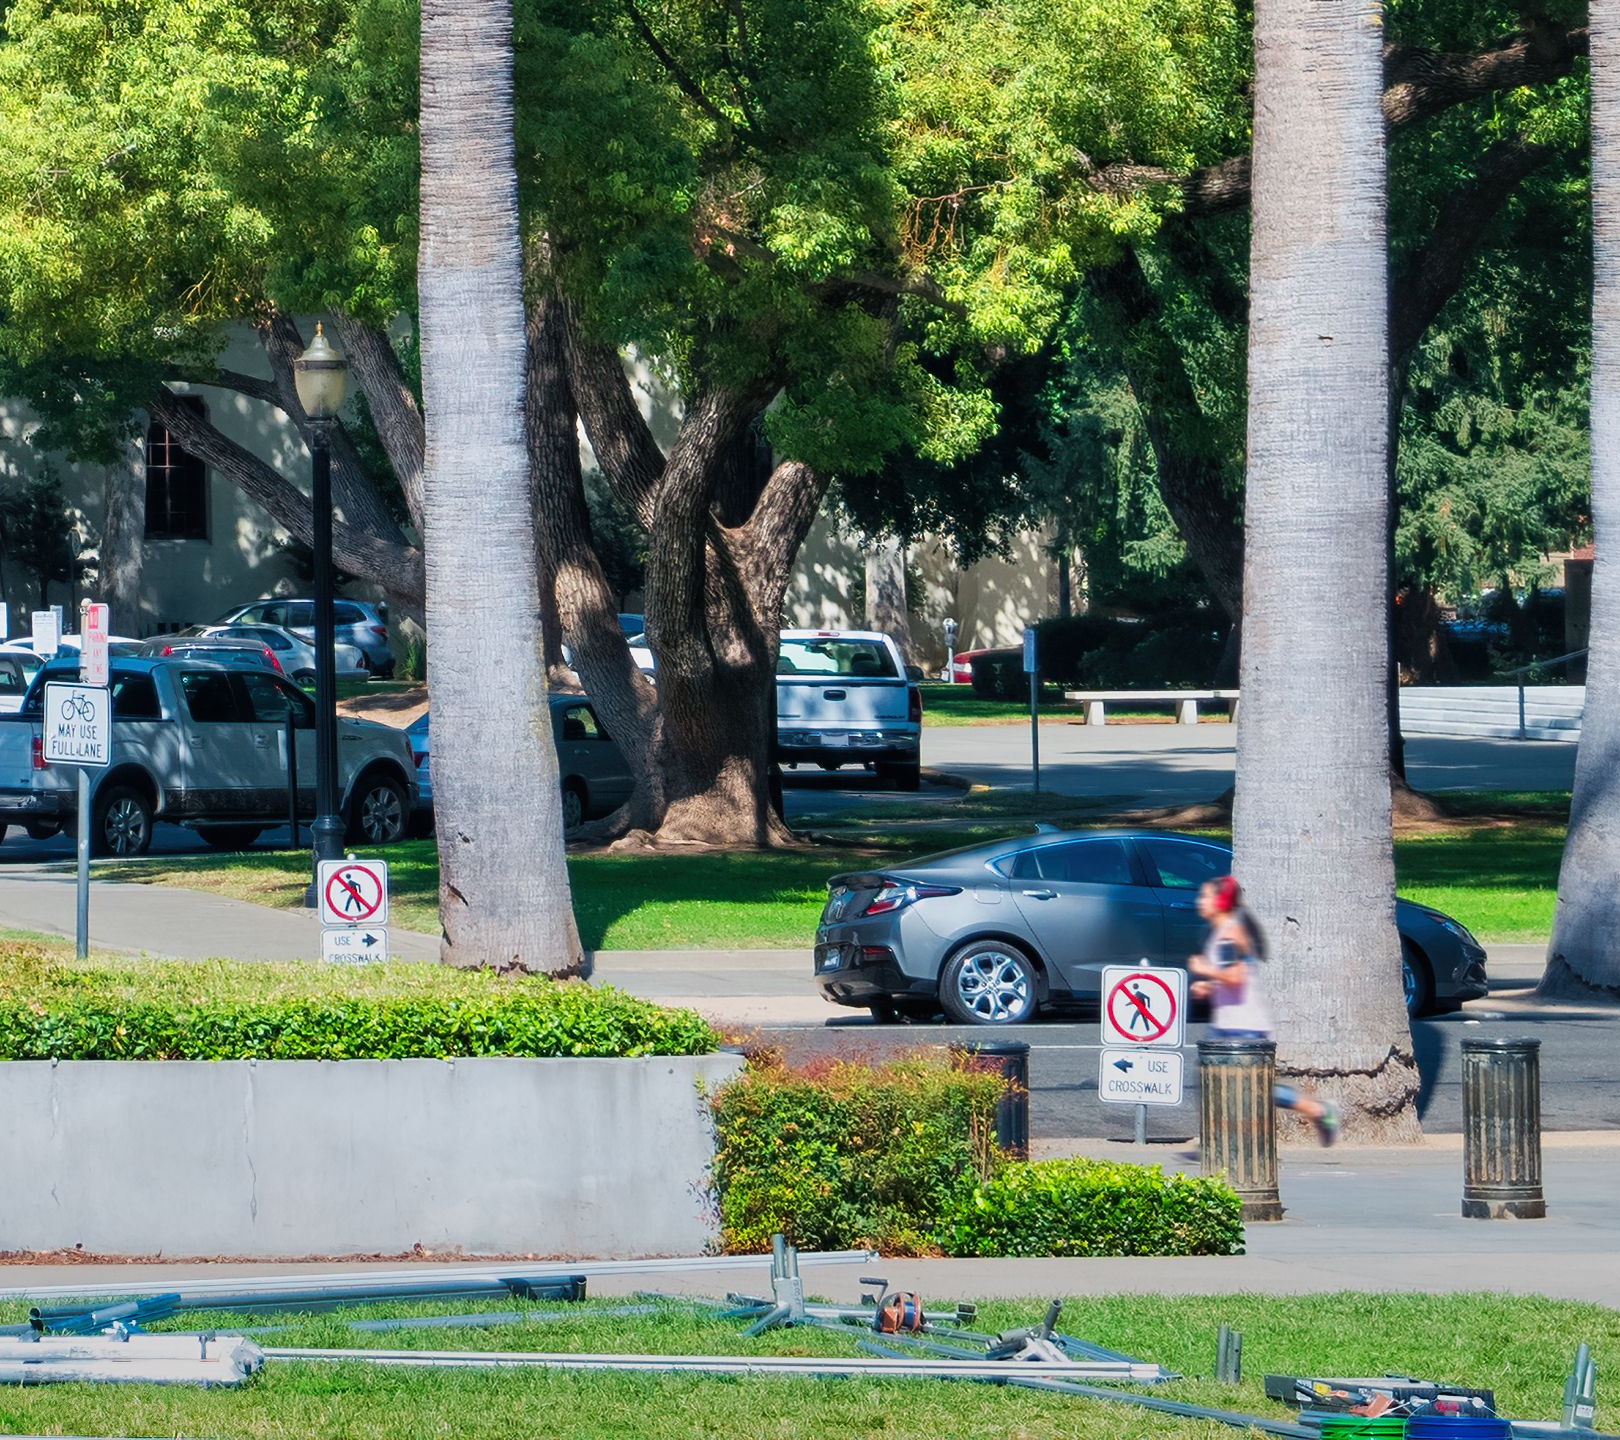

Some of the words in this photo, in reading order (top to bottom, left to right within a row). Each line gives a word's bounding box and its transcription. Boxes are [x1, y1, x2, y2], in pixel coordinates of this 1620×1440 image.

[57, 723, 77, 738] MAY
[79, 725, 98, 740] USE
[51, 739, 76, 756] FULL
[78, 742, 103, 759] LANE
[334, 936, 352, 946] USE
[328, 952, 382, 964] CROSSWALK
[1147, 1060, 1169, 1074] USE
[1108, 1079, 1173, 1095] CROSSWALK
